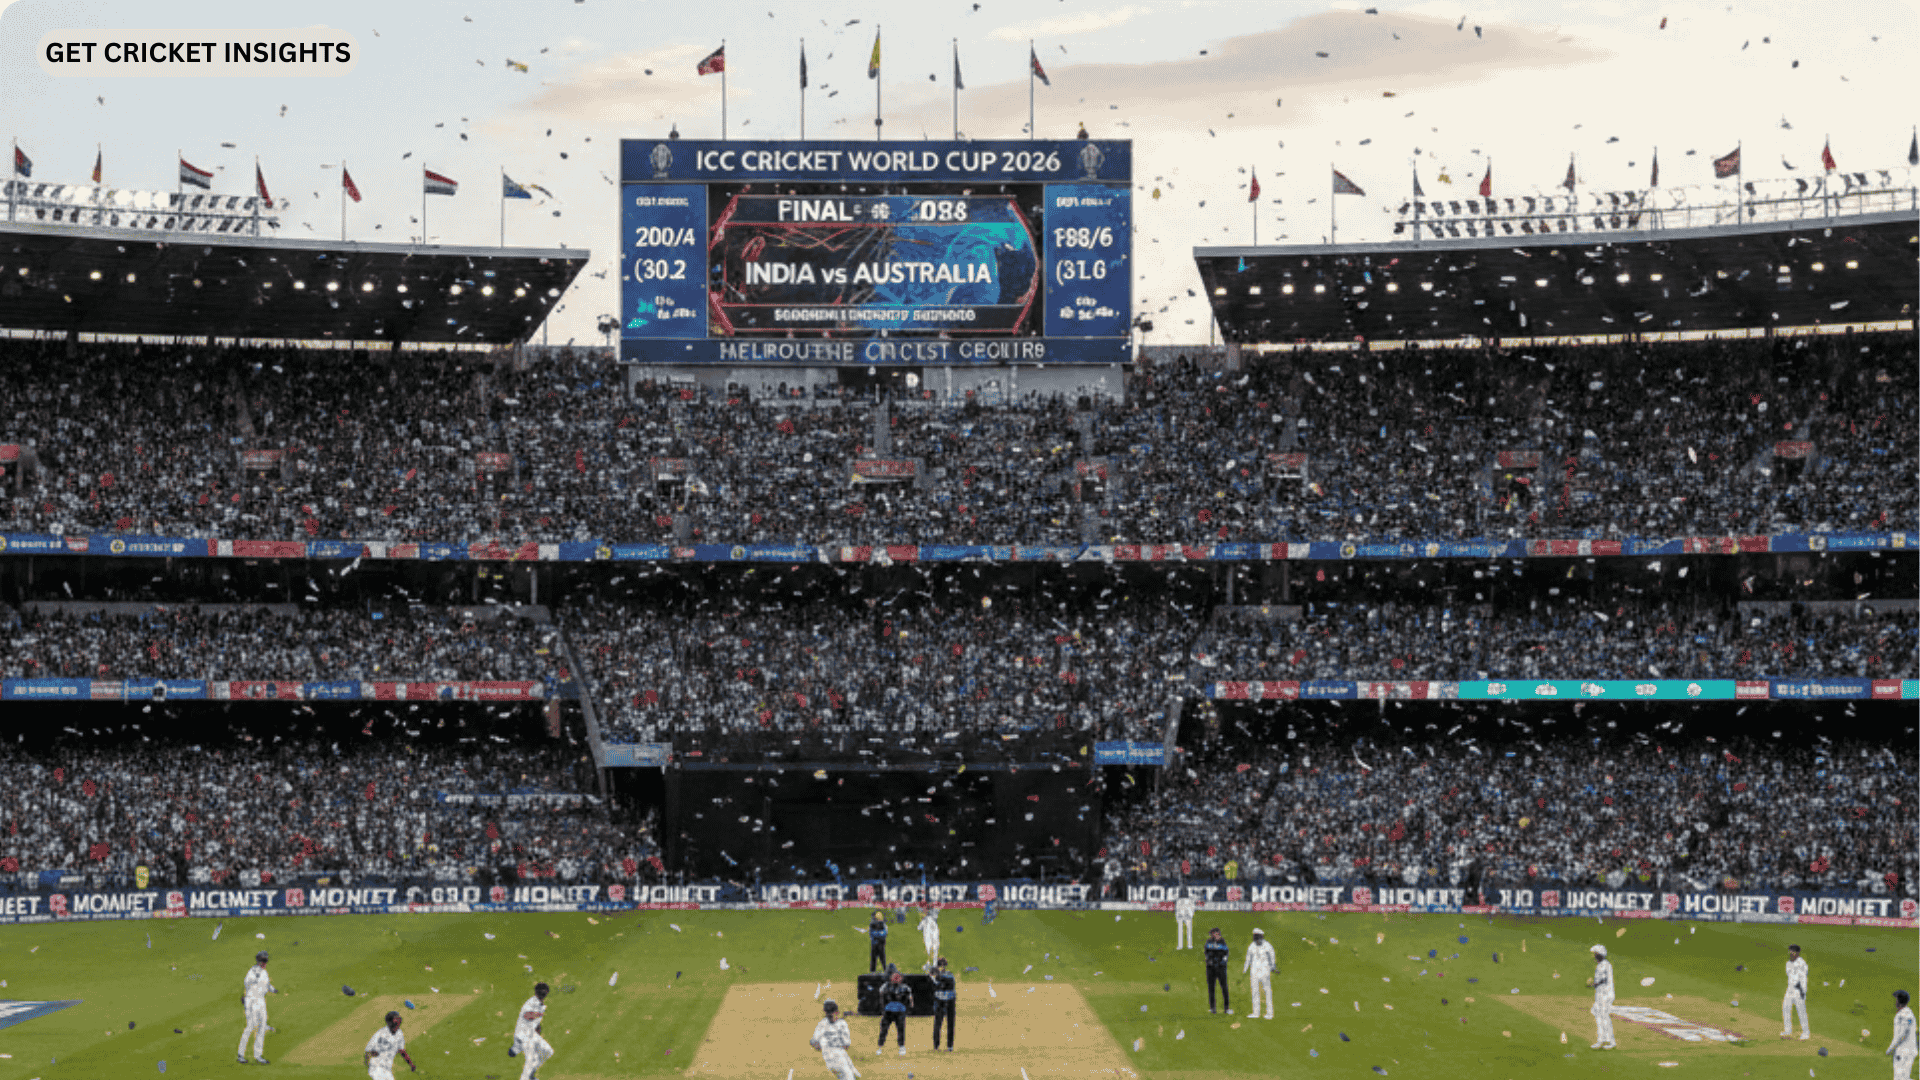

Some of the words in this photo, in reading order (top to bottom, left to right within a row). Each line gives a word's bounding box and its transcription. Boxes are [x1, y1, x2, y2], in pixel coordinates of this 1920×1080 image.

[697, 150, 735, 171] ICC
[741, 150, 842, 171] CRICKET
[848, 150, 939, 171] WORLD
[945, 150, 996, 171] CUP
[1001, 150, 1061, 171] 2026
[635, 226, 695, 247] 200/4
[746, 262, 816, 284] INDIA
[853, 262, 992, 284] AUSTRALIA
